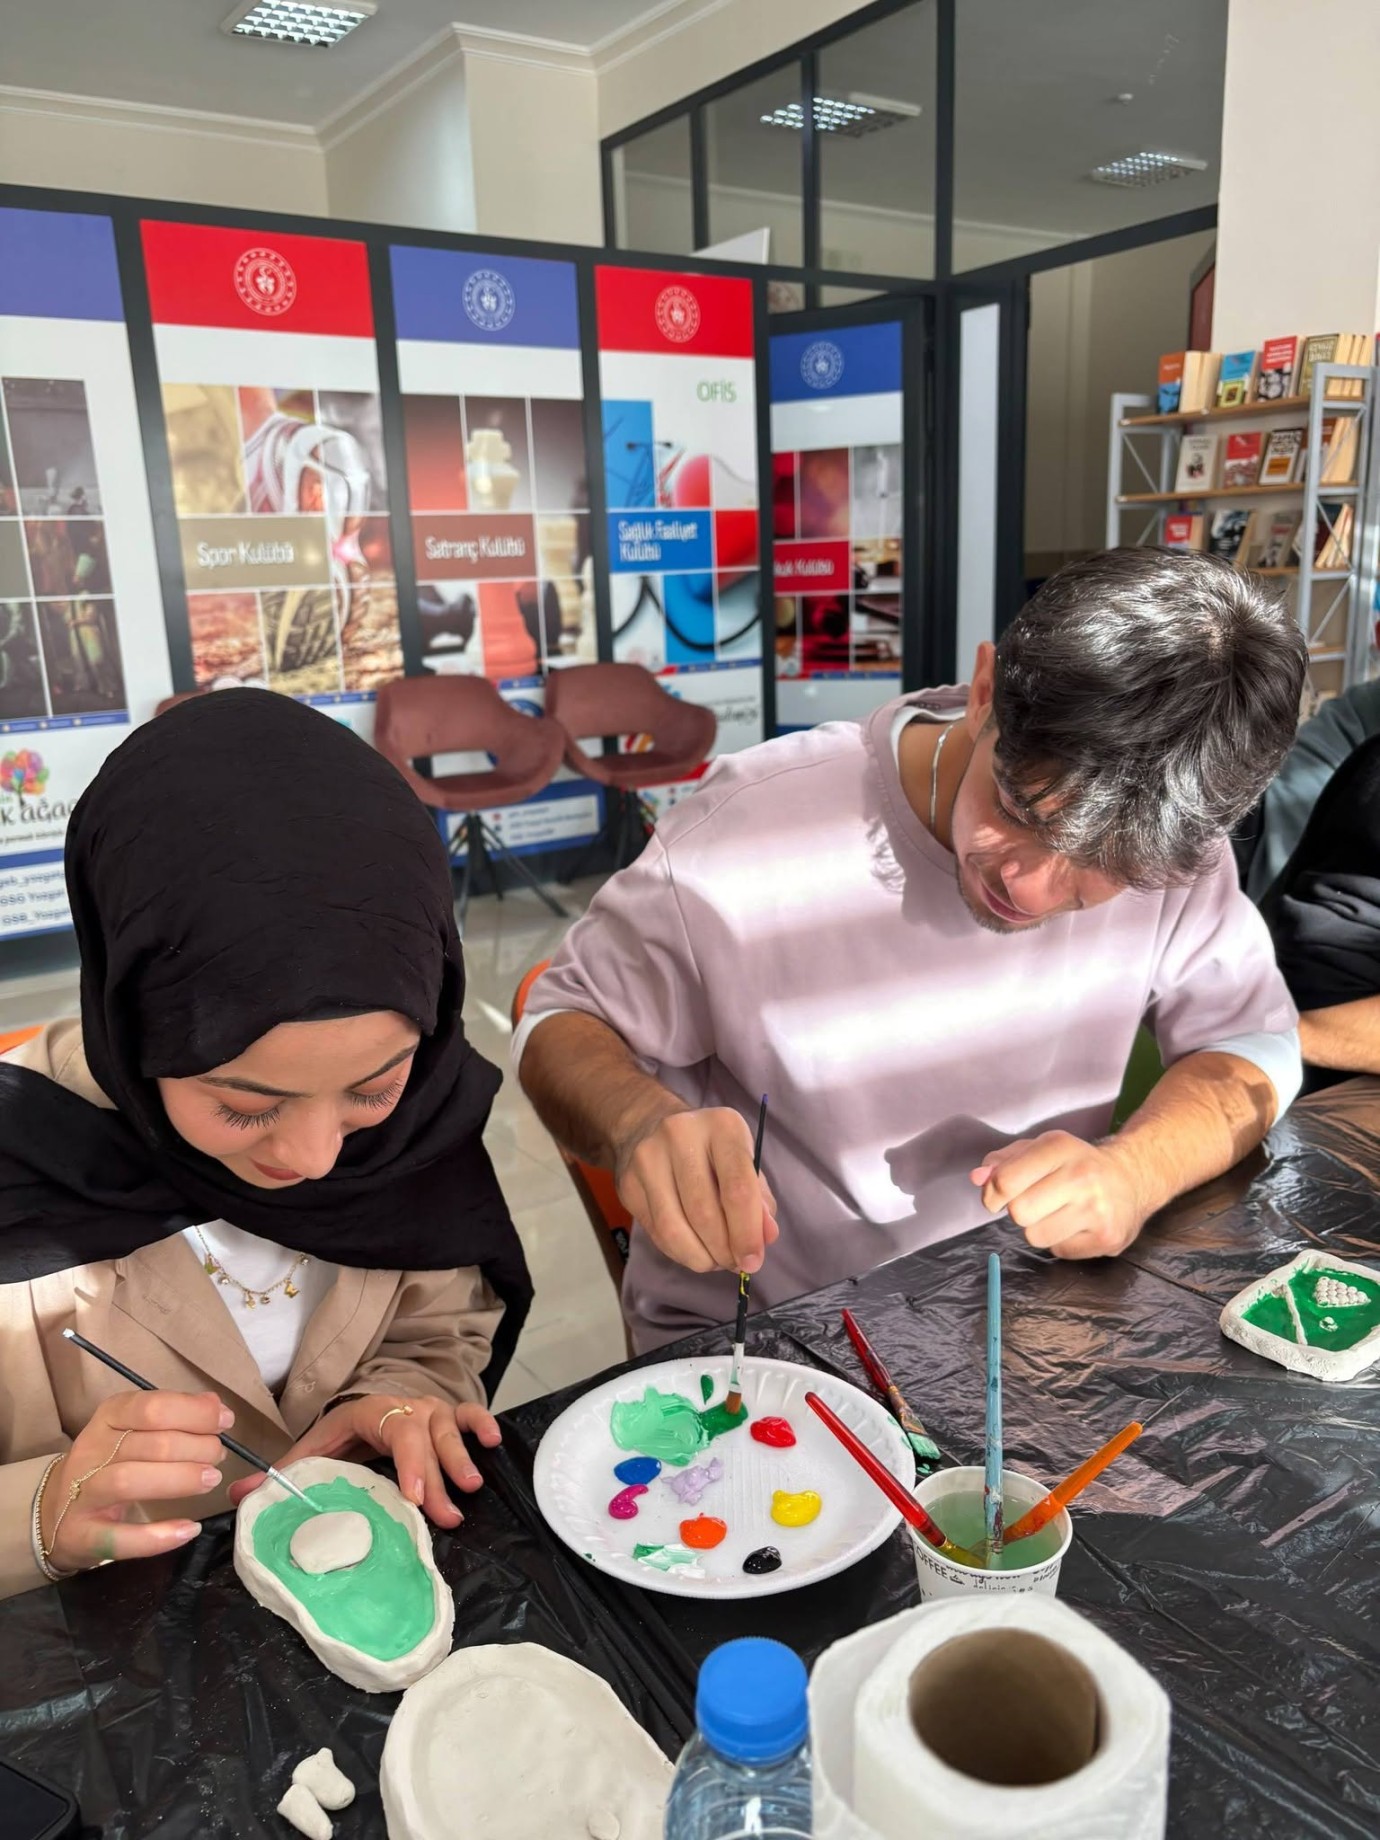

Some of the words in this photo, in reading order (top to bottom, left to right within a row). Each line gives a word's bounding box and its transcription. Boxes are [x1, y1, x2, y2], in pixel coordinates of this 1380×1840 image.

[197, 541, 236, 569] Spor
[238, 540, 294, 565] Kulübü
[425, 536, 478, 564] Satranç
[479, 536, 525, 557] Kulübü
[620, 541, 661, 561] Kulübü
[916, 1545, 949, 1580] OFFEE
